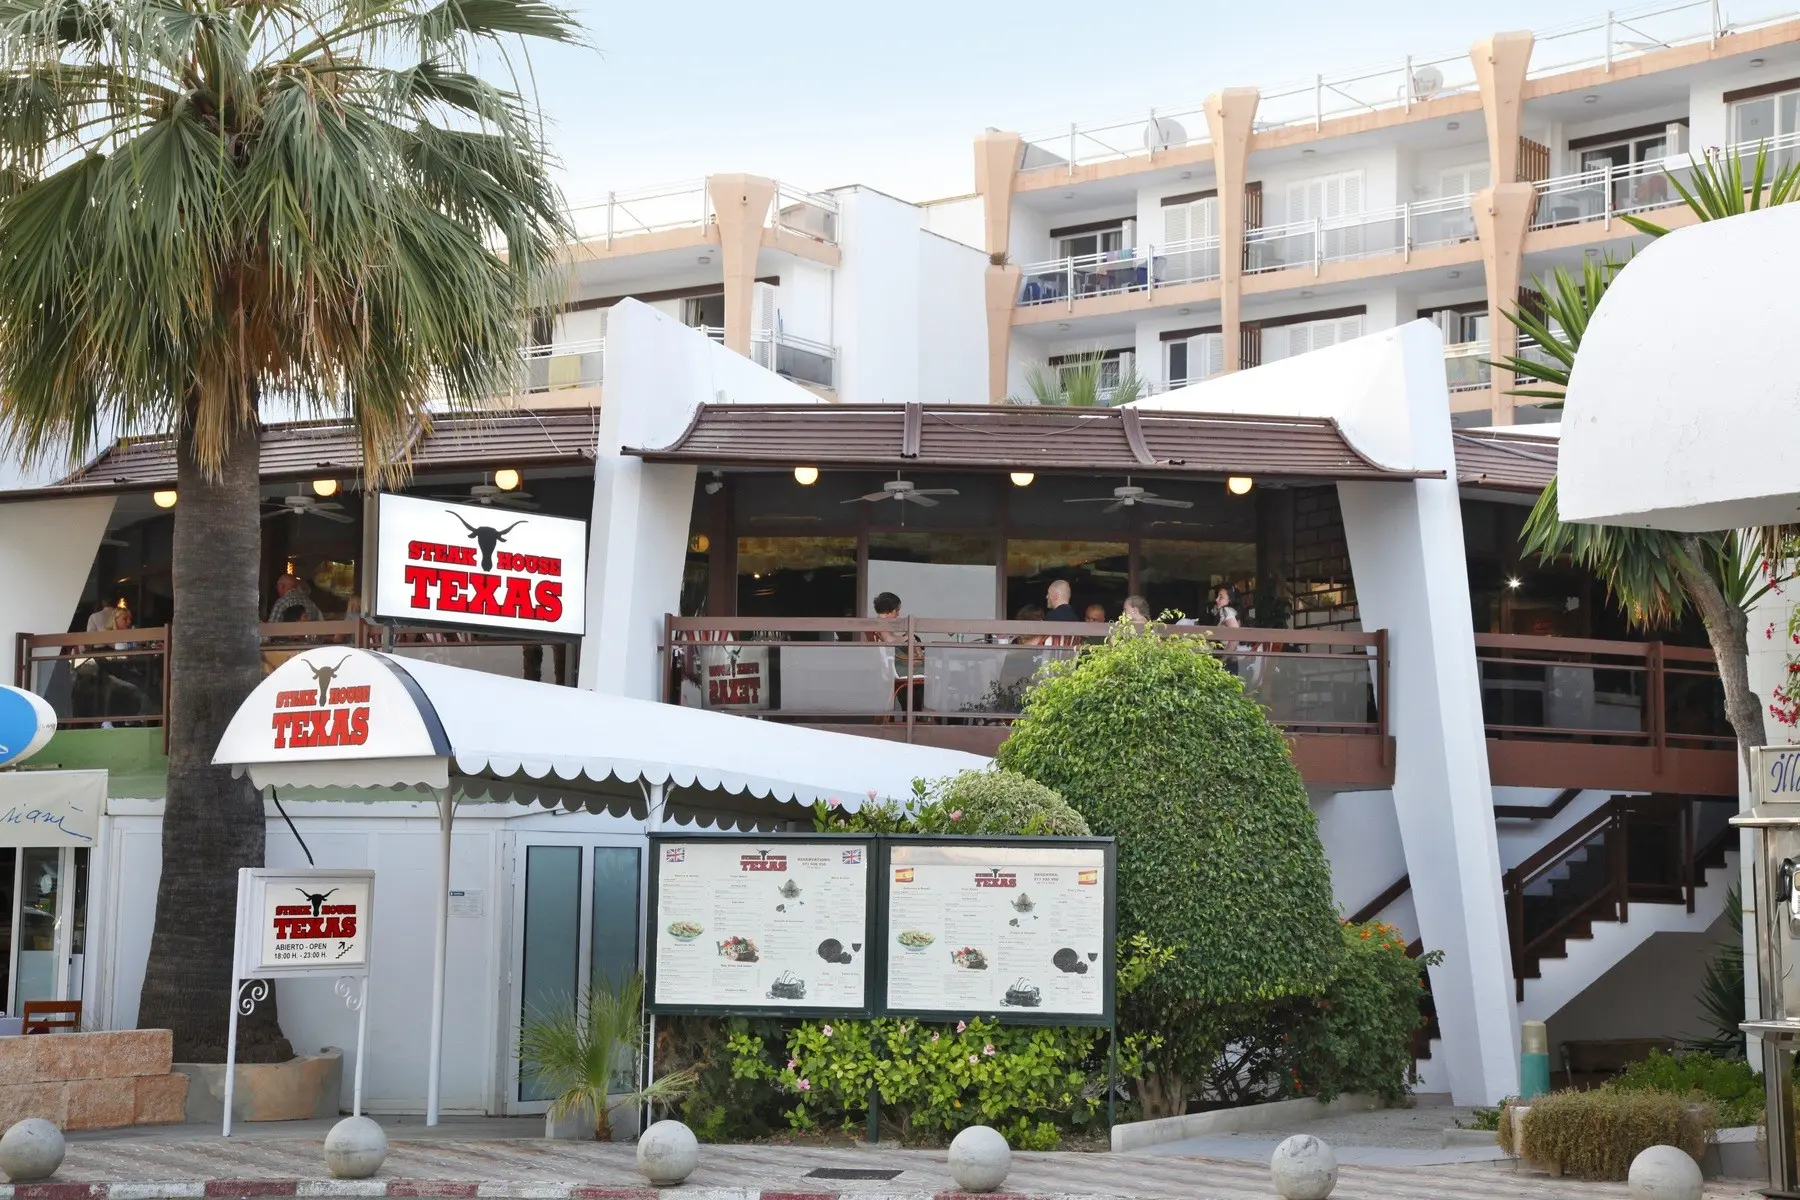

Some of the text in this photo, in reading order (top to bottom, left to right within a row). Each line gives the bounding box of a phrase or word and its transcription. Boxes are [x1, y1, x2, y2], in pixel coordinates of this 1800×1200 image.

[408, 540, 561, 576] STEAK HOUSE
[405, 565, 563, 622] TEXAS
[276, 685, 371, 708] STEAK HOUSE
[272, 707, 370, 749] TEXAS
[740, 861, 788, 871] TEXAS
[975, 878, 1017, 888] TEXAS
[276, 905, 356, 915] STEAK HOUSE
[273, 917, 356, 939] TEXAS
[275, 943, 304, 951] ABIERTO
[309, 942, 327, 950] OPEN
[274, 952, 291, 960] 18:00
[303, 951, 320, 959] 23:00
